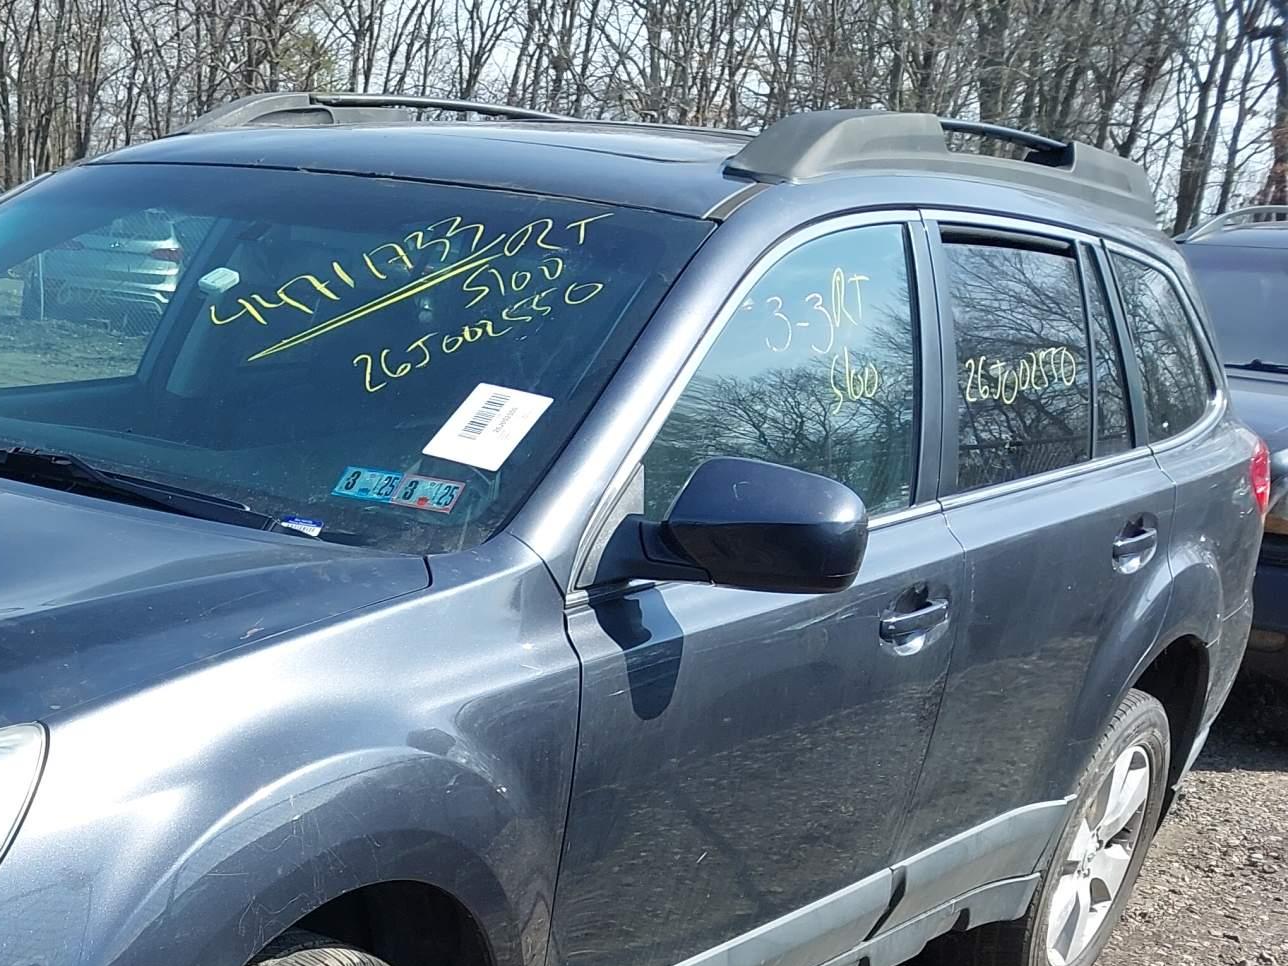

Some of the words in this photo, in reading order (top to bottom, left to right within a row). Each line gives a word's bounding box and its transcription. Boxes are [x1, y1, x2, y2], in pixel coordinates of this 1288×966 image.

[345, 471, 361, 490] 3
[377, 476, 400, 496] 25
[403, 480, 419, 500] 3
[436, 486, 459, 506] 25
